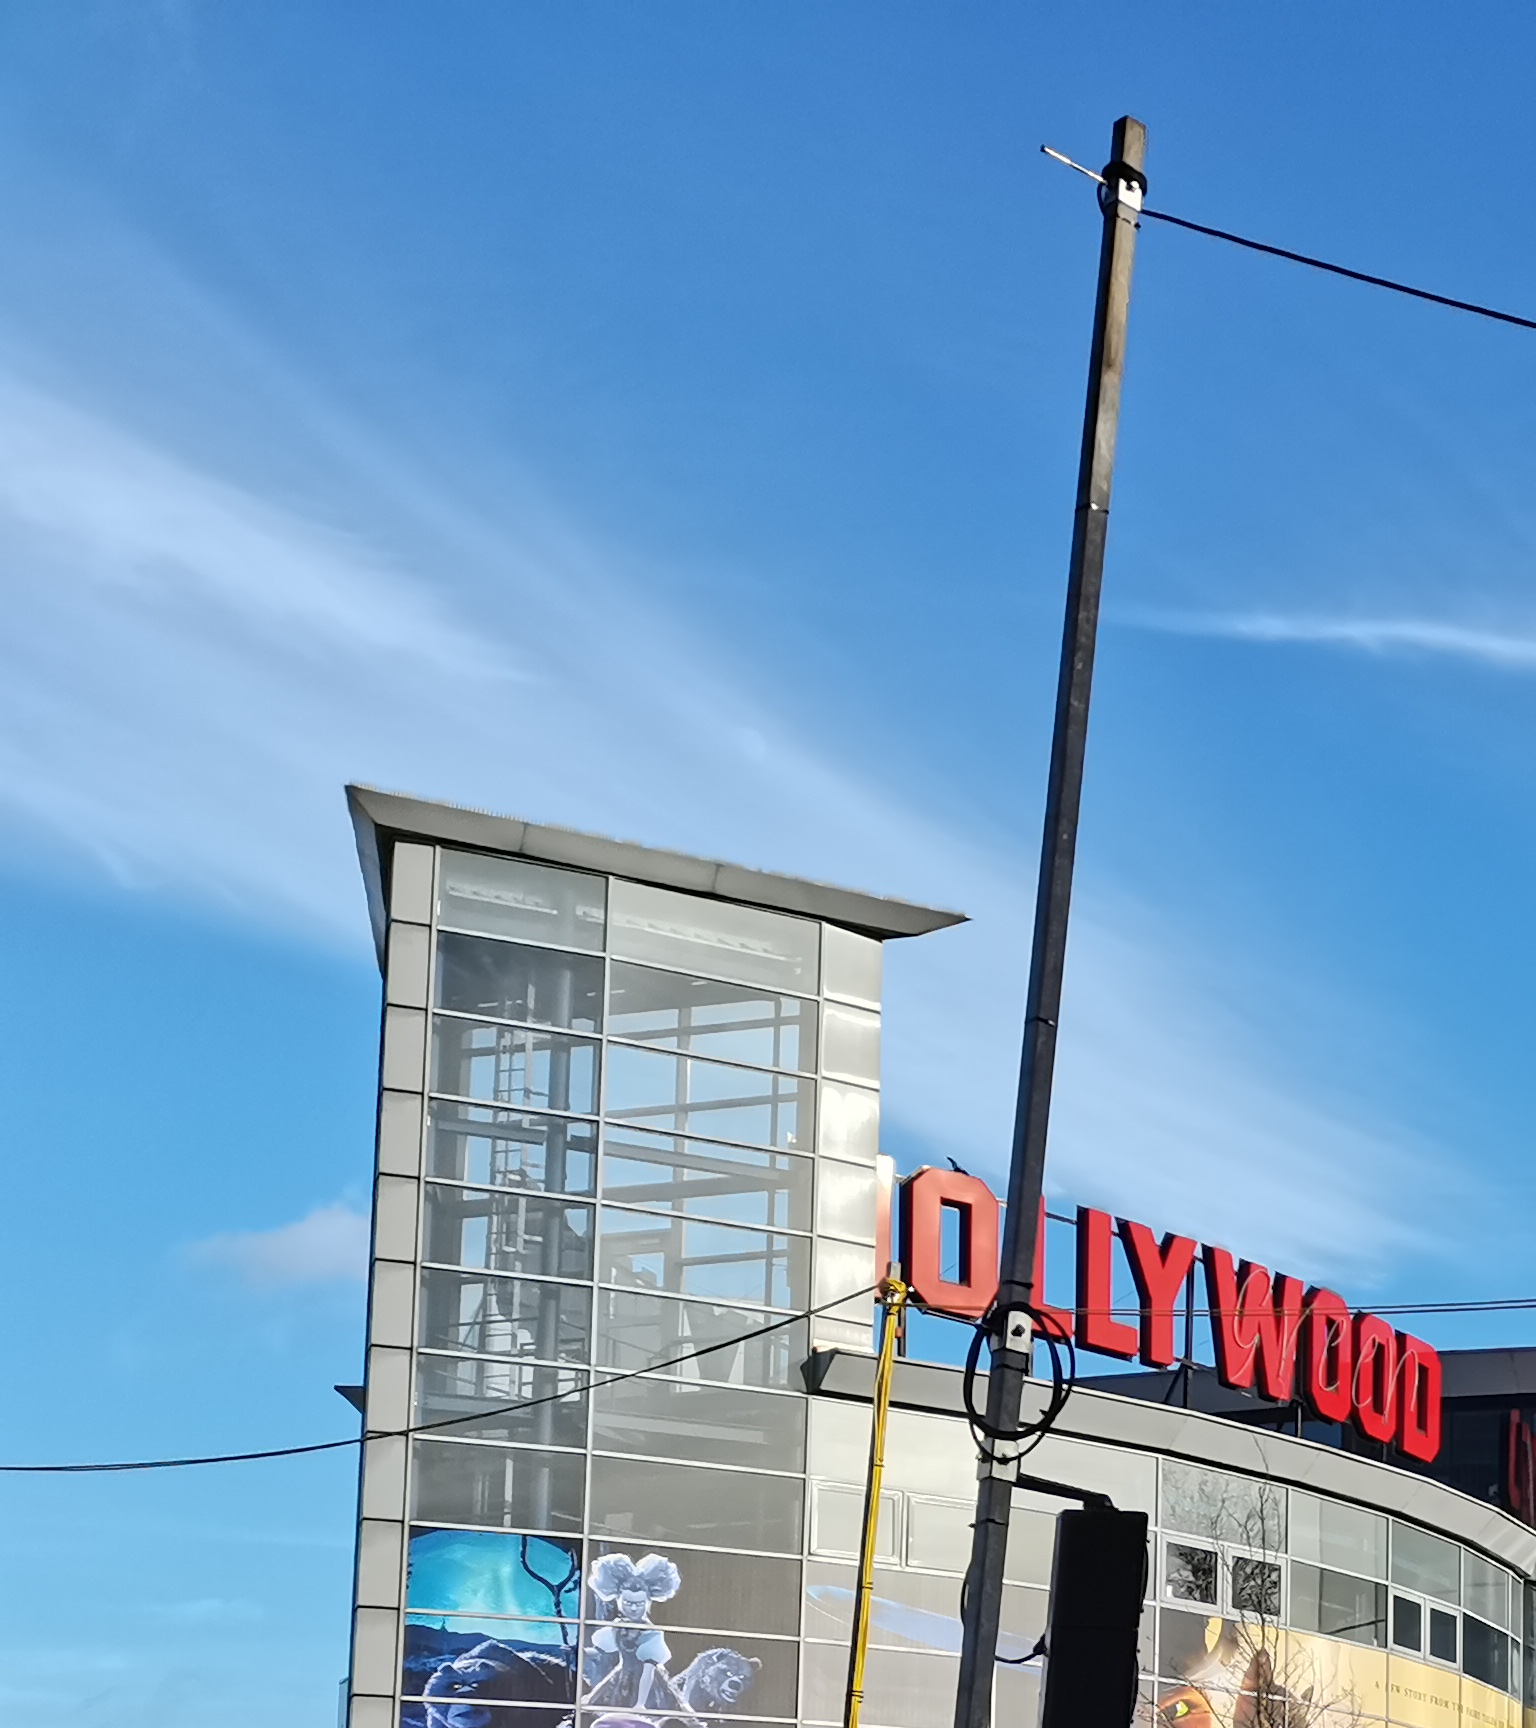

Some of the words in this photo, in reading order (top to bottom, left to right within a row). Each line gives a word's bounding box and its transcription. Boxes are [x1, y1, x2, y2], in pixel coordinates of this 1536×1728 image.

[876, 1155, 1442, 1463] OLLYWOOD
[1404, 1687, 1427, 1704] STORY
[1430, 1694, 1451, 1711] FROM
